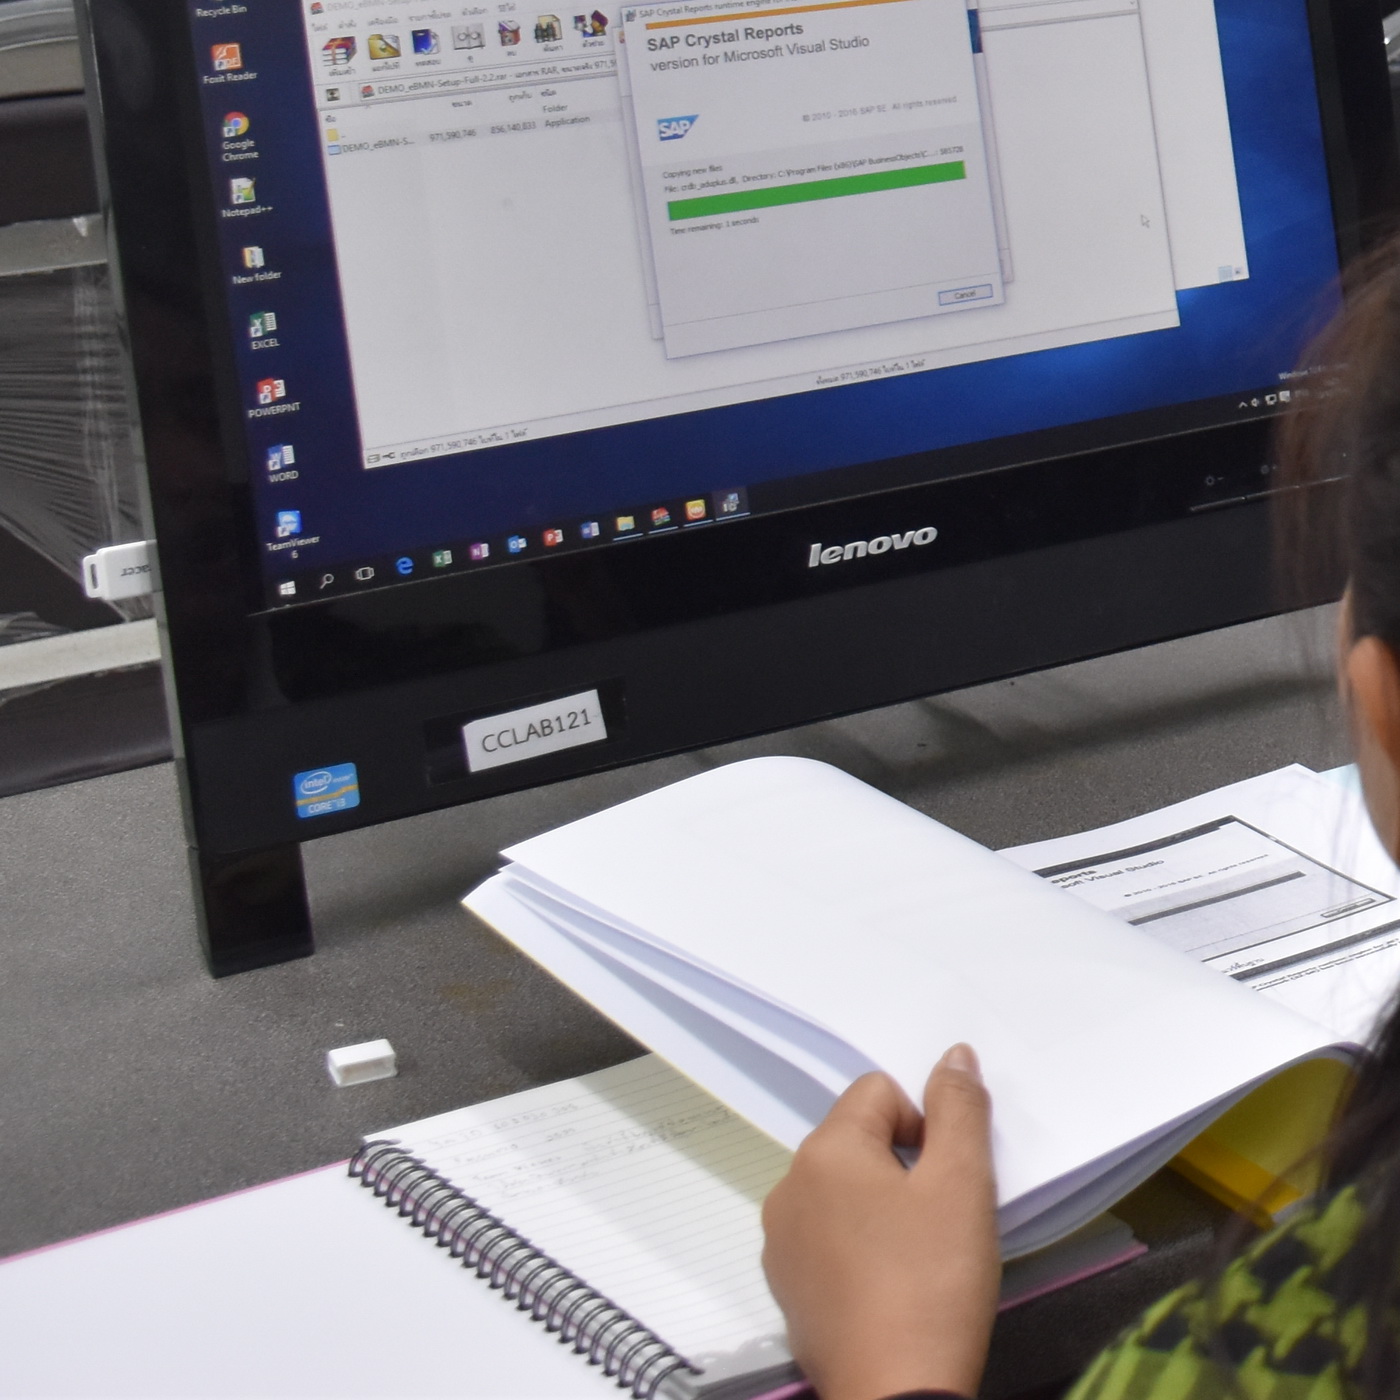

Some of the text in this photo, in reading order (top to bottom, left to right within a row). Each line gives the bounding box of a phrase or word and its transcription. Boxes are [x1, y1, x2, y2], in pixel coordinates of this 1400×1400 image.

[195, 4, 247, 18] Recycle Bin
[639, 9, 655, 18] SAP
[657, 6, 683, 17] Crystal
[684, 3, 713, 14] Reports
[715, 0, 744, 10] runtime
[647, 23, 804, 51] SAP Crystal Reports
[650, 35, 870, 71] version for Microsoft Visual Studio
[203, 72, 258, 84] Foxit Reader
[542, 103, 568, 113] Folder
[545, 114, 590, 129] Application
[658, 119, 691, 138] SAP
[222, 139, 255, 150] Google
[222, 151, 259, 161] Chrome
[663, 169, 691, 179] Copying
[708, 165, 723, 173] files
[222, 205, 273, 218] Notepad++
[731, 217, 760, 226] seconds
[233, 270, 282, 284] New folder
[954, 288, 976, 300] Cancel
[251, 338, 280, 350] EXCEL
[248, 402, 301, 418] POWERPNT
[268, 470, 299, 482] WORD
[267, 534, 320, 551] TeamViewer
[808, 526, 938, 568] lenovo
[291, 551, 298, 559] 6
[481, 708, 592, 753] CCLAB121
[304, 774, 330, 789] intel
[1051, 869, 1097, 885] eports
[1061, 859, 1166, 889] soft Visual Studio
